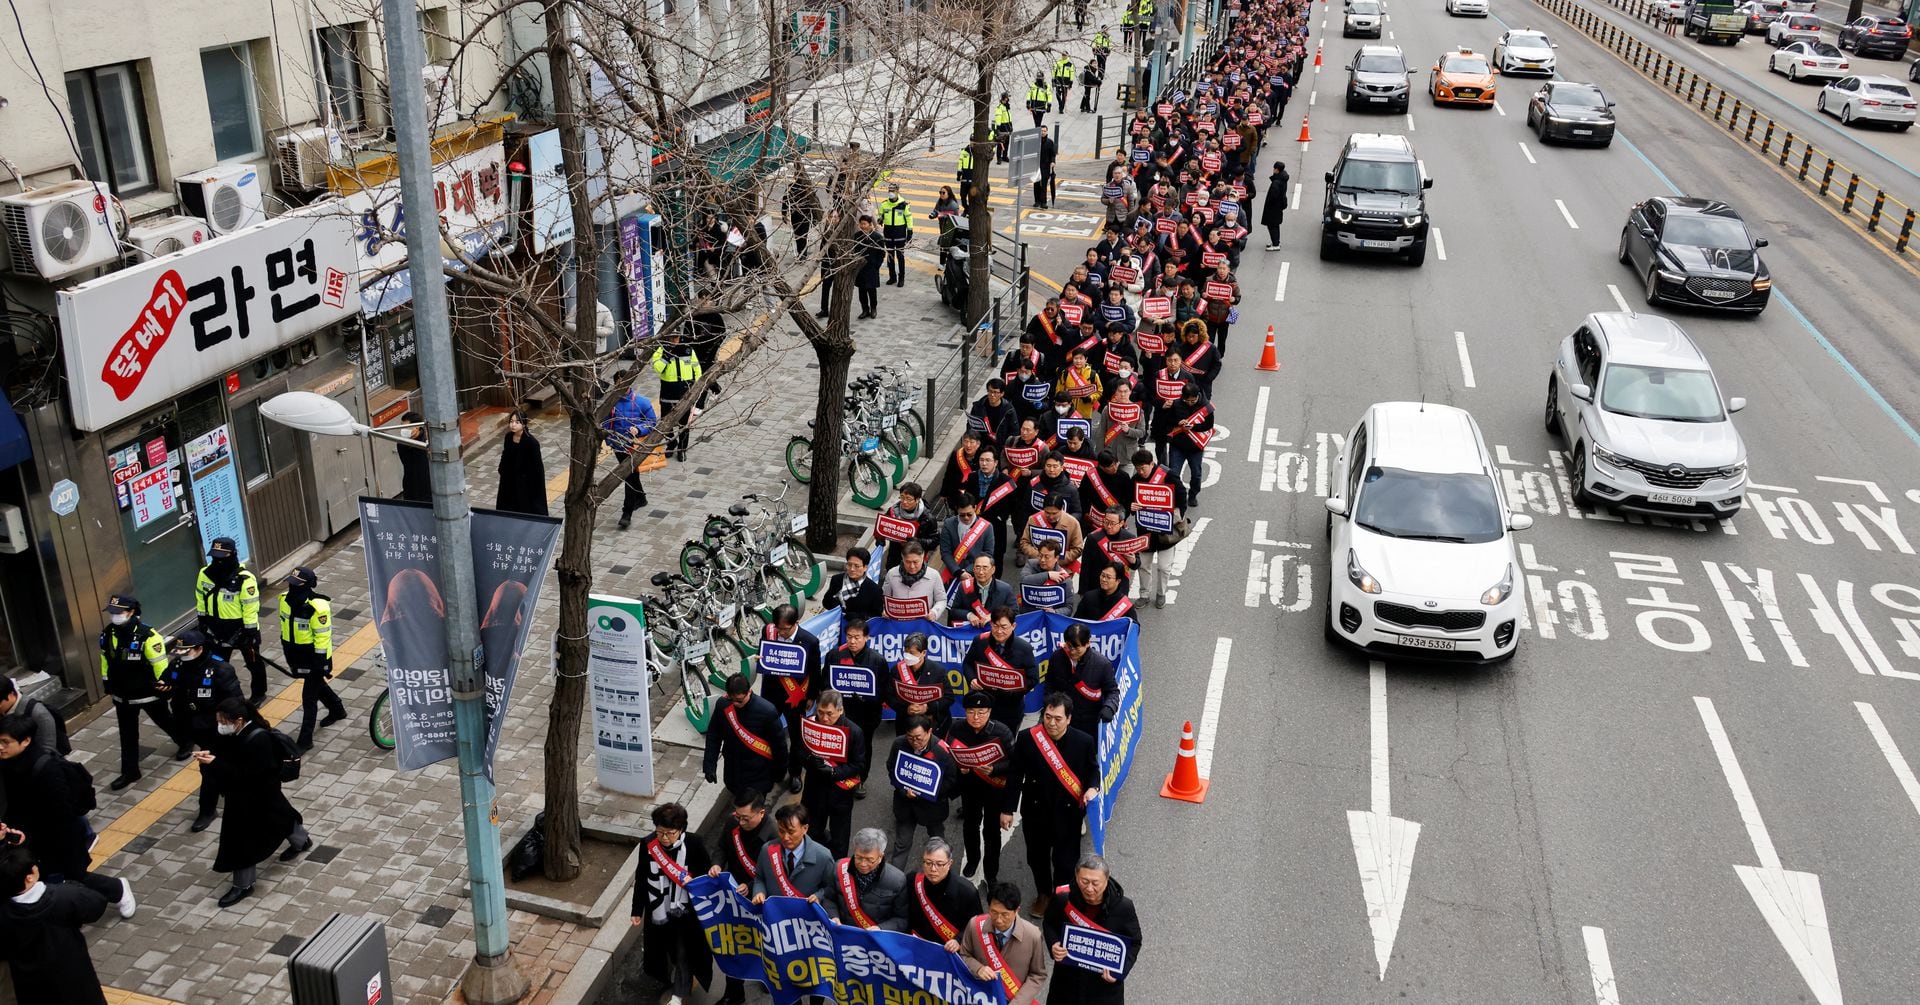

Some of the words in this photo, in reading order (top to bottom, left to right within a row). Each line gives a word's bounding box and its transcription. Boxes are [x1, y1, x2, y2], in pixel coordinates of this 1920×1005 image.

[186, 239, 321, 352] 라면
[56, 487, 73, 507] ADT
[1671, 495, 1693, 504] 5068
[138, 507, 149, 523] 김
[162, 495, 172, 510] 밥
[1428, 639, 1453, 650] 5336
[765, 655, 780, 663] 정부는
[779, 657, 800, 666] 이행하라
[769, 648, 778, 656] 9.4
[778, 649, 798, 658] 의정합의
[836, 679, 850, 687] 정부는
[850, 680, 869, 688] 이행하라
[847, 673, 867, 681] 의정합의
[904, 760, 912, 769] 9.4
[912, 763, 933, 776] 의정합의
[900, 769, 913, 779] 정부는
[912, 774, 933, 785] 이행하라
[1069, 934, 1095, 946] 의료계와
[1096, 940, 1121, 954] 합의없는
[1068, 943, 1094, 956] 의대증원
[1094, 950, 1120, 963] 결사반대
[841, 945, 897, 982] 증원
